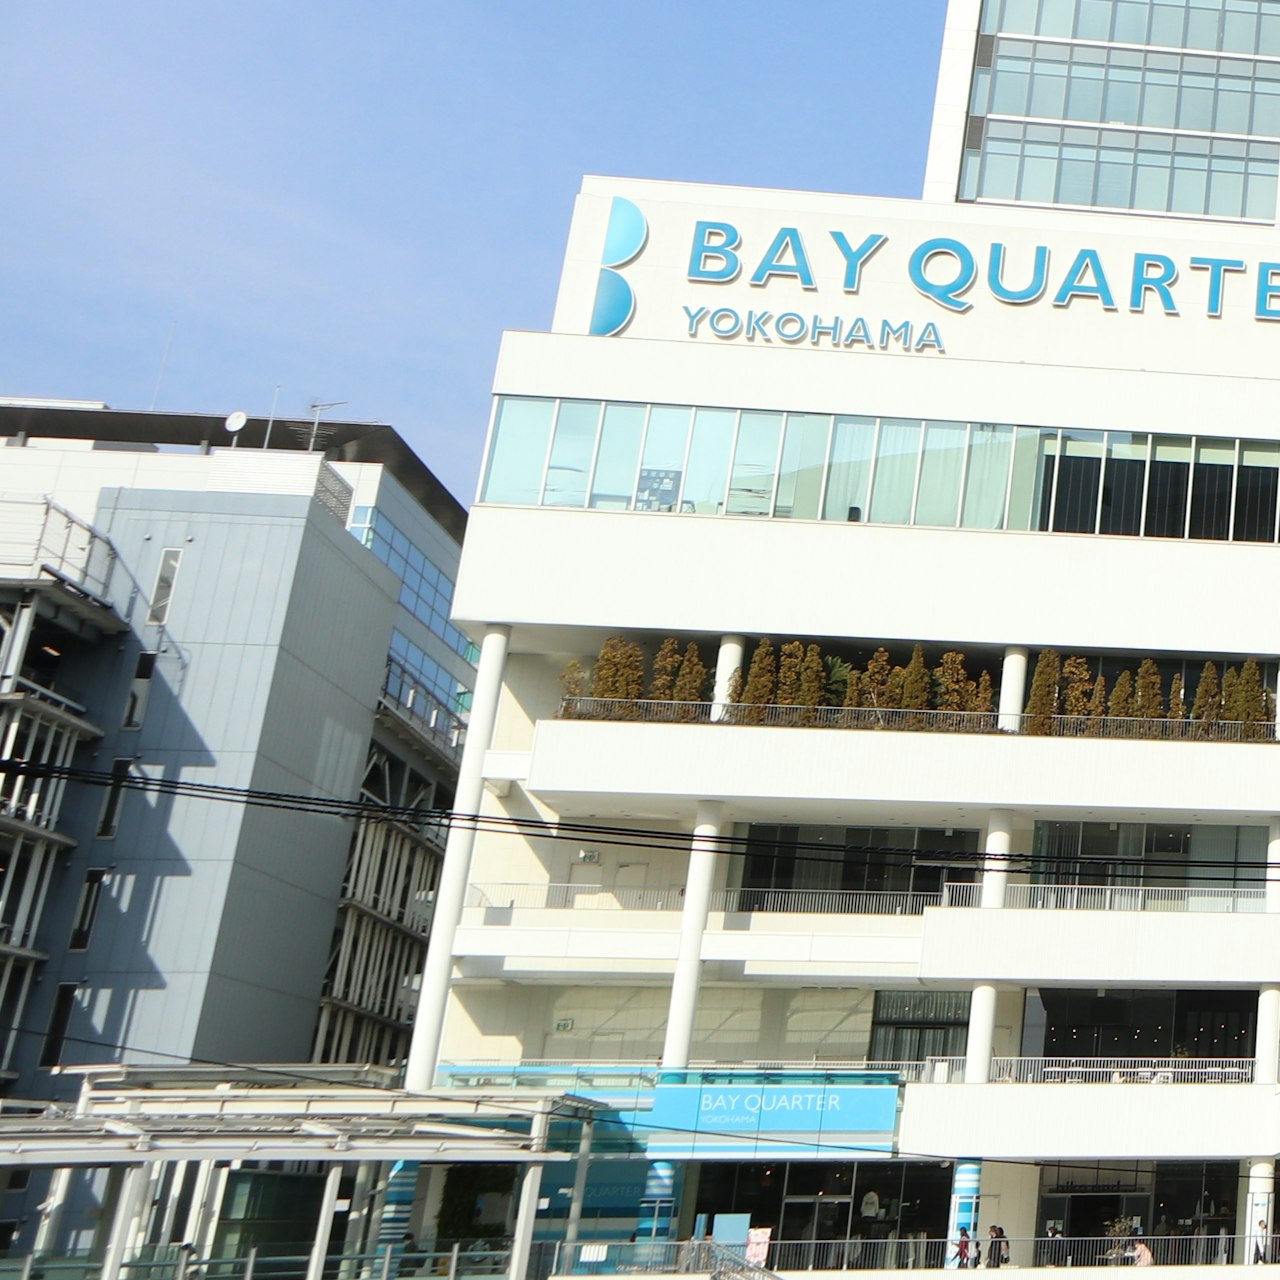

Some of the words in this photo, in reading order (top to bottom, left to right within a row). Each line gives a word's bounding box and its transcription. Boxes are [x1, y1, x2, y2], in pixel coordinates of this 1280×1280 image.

[687, 220, 888, 294] BAY
[682, 306, 946, 353] YOKOHAMA
[702, 1094, 741, 1111] BAY
[744, 1094, 841, 1113] QUARTER
